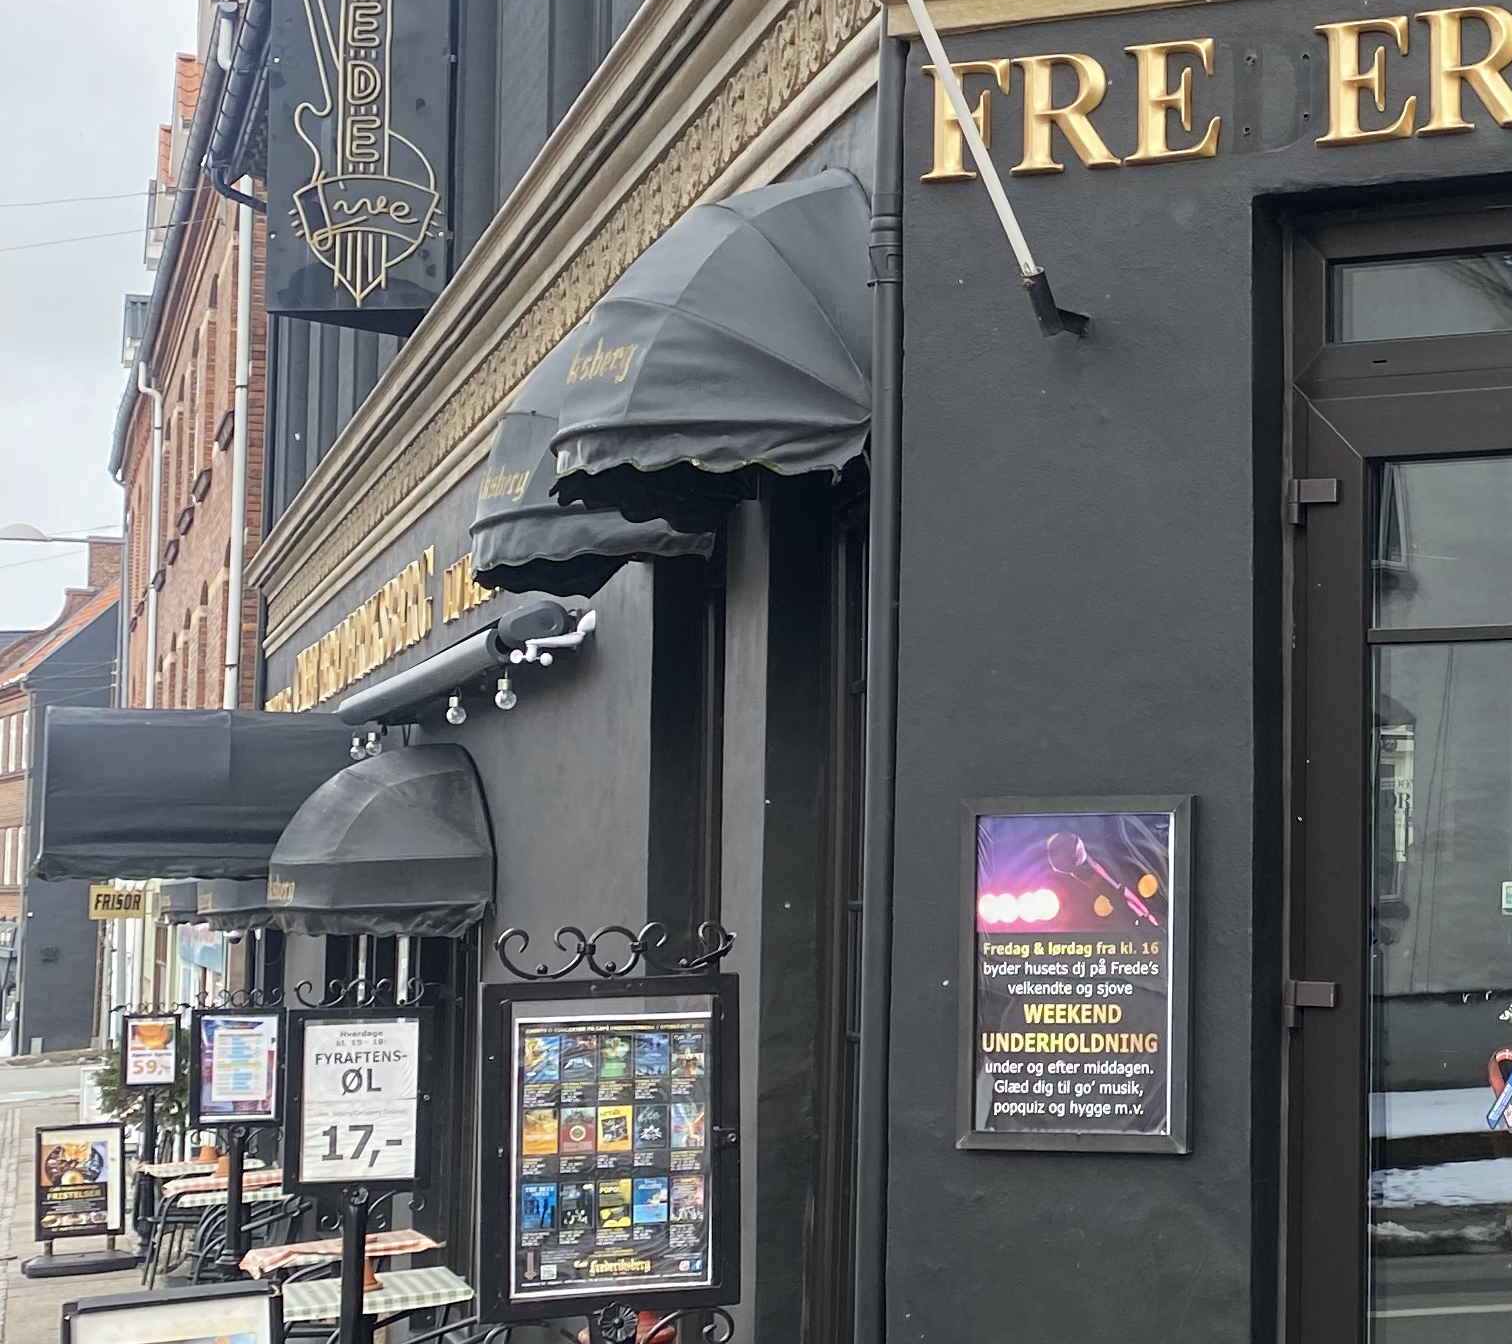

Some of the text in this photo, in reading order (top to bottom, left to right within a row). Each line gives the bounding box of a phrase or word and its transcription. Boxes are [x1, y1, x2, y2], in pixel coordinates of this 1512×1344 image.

[920, 37, 1221, 183] FRE
[983, 942, 1159, 958] Fredag & lørdag fra kl. 16
[983, 961, 1021, 977] byder
[1024, 962, 1068, 975] husets
[1072, 961, 1085, 978] dj
[1090, 958, 1106, 977] på
[1008, 981, 1133, 998] velkendte og sjove
[1023, 1003, 1122, 1024] WEEKEND
[982, 1032, 1158, 1053] UNDERHOLDNING
[315, 1050, 407, 1065] FYRAFTENS-
[985, 1060, 1154, 1077] under og efter middagen.
[341, 1067, 382, 1096] ØL
[994, 1079, 1029, 1093] Glæd
[1033, 1080, 1053, 1096] dig
[1057, 1080, 1070, 1094] til
[1099, 1081, 1144, 1097] musik,
[993, 1100, 1144, 1117] popquiz og hygge m.v.
[321, 1124, 402, 1168] 17,-
